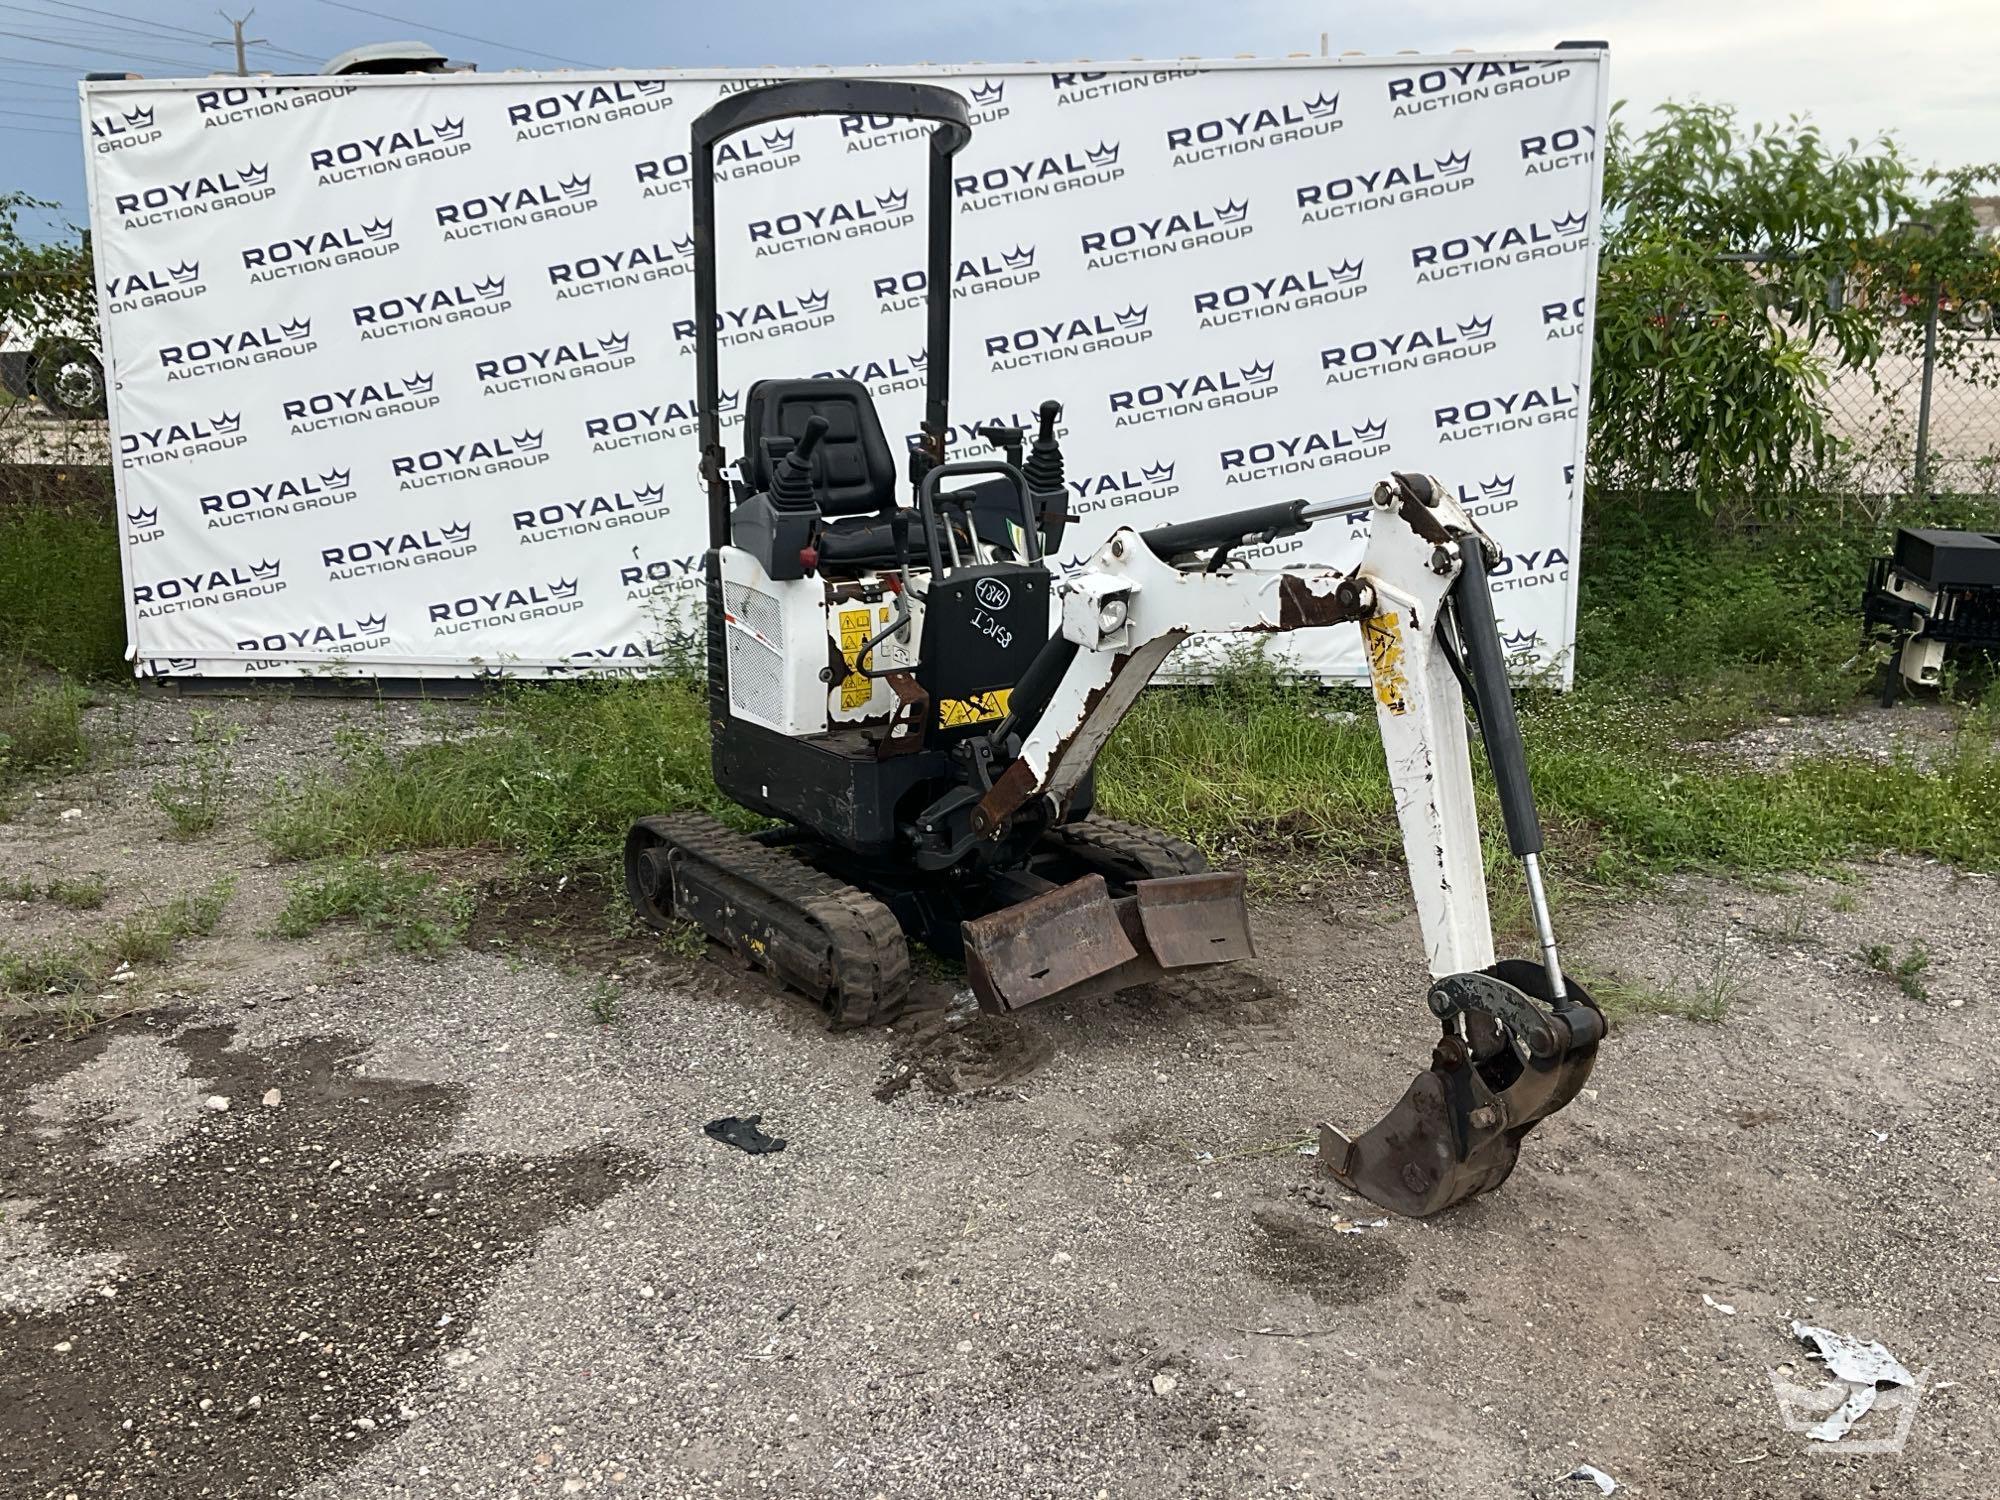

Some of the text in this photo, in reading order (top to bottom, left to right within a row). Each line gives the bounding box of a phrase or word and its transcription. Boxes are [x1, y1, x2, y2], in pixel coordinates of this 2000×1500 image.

[506, 82, 635, 125] ROYAL
[1057, 75, 1148, 106] AUCTION
[1393, 68, 1571, 118] AUCTION GROUP
[204, 100, 288, 128] AUCTION
[515, 97, 673, 141] AUCTION GROUP
[1166, 104, 1304, 150] ROYAL
[96, 129, 162, 153] GROUP
[309, 127, 434, 170] ROYAL
[846, 123, 935, 153] AUCTION
[1172, 119, 1343, 167] AUCTION GROUP
[318, 142, 471, 186] AUCTION GROUP
[634, 139, 763, 182] ROAL
[642, 154, 800, 198] AUCTN GROUP
[953, 153, 1086, 197] ROYAL
[1525, 148, 1594, 176] AUCTI
[114, 173, 239, 215] ROYAL
[434, 184, 561, 226] ROYAL
[960, 168, 1124, 213] AUCTION GROUP
[1295, 162, 1434, 207] ROYAL
[1301, 177, 1474, 224] AUCTION GROUP
[124, 187, 276, 230] AUCTION GROUP
[443, 199, 597, 242] AUCTION GROUP
[747, 199, 876, 242] ROYAL
[240, 227, 364, 269] ROYAL
[755, 214, 914, 258] AUCTION GROUP
[1080, 210, 1214, 254] ROYAL
[1086, 225, 1253, 270] AUCTION GROUP
[1410, 222, 1551, 267] ROYAL
[250, 242, 400, 284] AUCTION GROUP
[547, 244, 673, 284] ROYAL
[555, 261, 696, 300] AUCTION GROU
[872, 256, 1003, 298] ROAL
[1416, 237, 1591, 284] AUCTION GROUP
[140, 285, 206, 307] GROUP
[351, 286, 475, 326] ROYAL
[880, 271, 1040, 314] AUCTN GROUP
[1193, 270, 1328, 313] ROYAL
[1199, 284, 1367, 329] AUCTION GROUP
[360, 300, 512, 341] AUCTION GROUP
[679, 314, 835, 356] ATION GROUP
[984, 315, 1115, 357] ROYAL
[158, 327, 282, 367] ROYAL
[167, 341, 317, 381] AUCTION GROUP
[474, 341, 599, 381] ROYAL
[991, 329, 1152, 372] AUCTION GROUP
[1320, 326, 1457, 369] ROYAL
[1325, 341, 1496, 385] AUCTION GROUP
[483, 356, 635, 396] AUCTION GROUP
[877, 375, 928, 395] GROU
[1108, 371, 1240, 412] ROYAL
[281, 381, 404, 420] ROYAL
[290, 395, 440, 435] AUCTION GROUP
[1114, 385, 1278, 427] AUCTION GROUP
[1433, 385, 1572, 427] ROYAL
[181, 435, 247, 456] GROUP
[592, 427, 676, 453] AUCTION
[1219, 429, 1352, 470] ROYAL
[1439, 415, 1532, 443] AUCTION
[391, 438, 513, 476] ROYAL
[399, 452, 549, 491] AUCTION GROUP
[1225, 443, 1390, 485] AUCTION GROUP
[199, 476, 321, 514] ROYAL
[1068, 470, 1142, 497] YAL
[1109, 485, 1179, 507] GROUP
[207, 491, 357, 529] AUCTION GROUP
[512, 492, 634, 530] ROYAL
[520, 507, 670, 545] AUCTION GROUP
[320, 530, 442, 567] ROYAL
[329, 544, 477, 581] AUCTION GROUP
[133, 567, 251, 604] ROYAL
[138, 581, 286, 619] AUCTION GROUP
[427, 586, 548, 622] ROYAL
[434, 600, 583, 637] AUCTION GROUP
